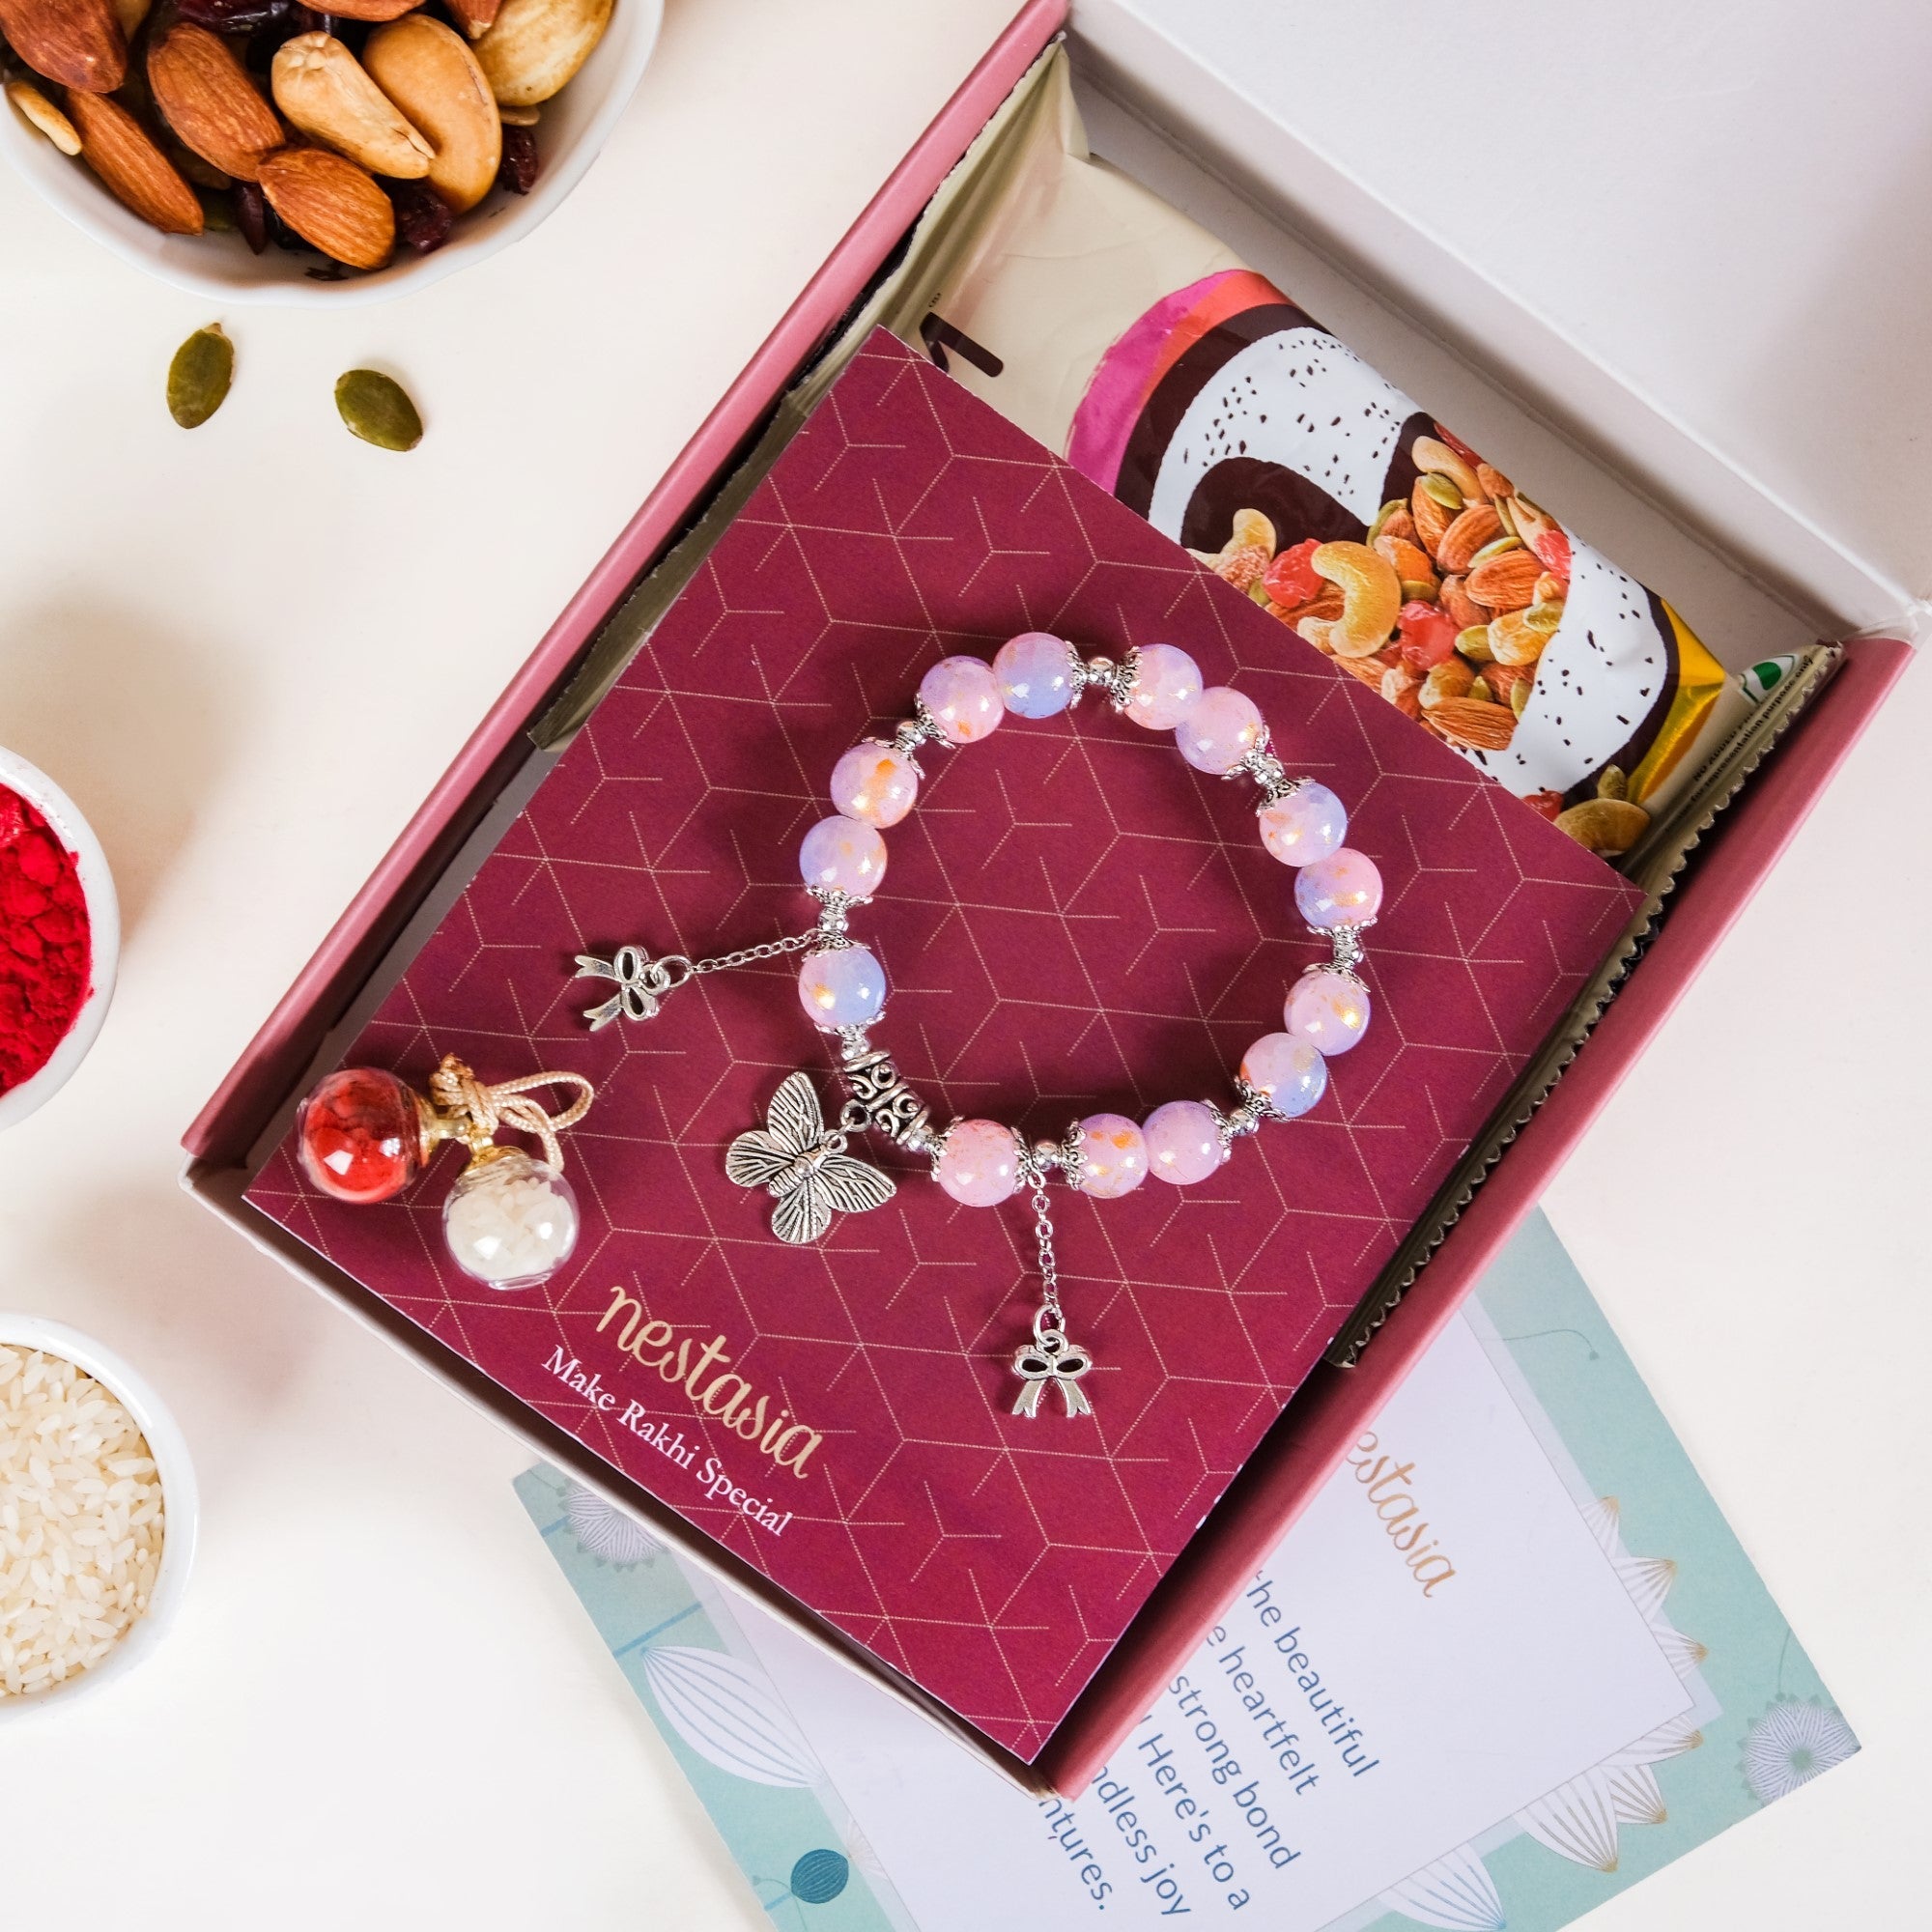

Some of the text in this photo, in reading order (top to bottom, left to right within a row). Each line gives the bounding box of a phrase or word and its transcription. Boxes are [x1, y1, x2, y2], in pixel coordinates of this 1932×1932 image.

[1762, 679, 1796, 720] purpose
[541, 1345, 794, 1537] Make Rakhi Special
[596, 1286, 823, 1479] nestasia
[1169, 1676, 1302, 1868] strong bond
[1219, 1646, 1321, 1795] heartfelt
[1273, 1626, 1380, 1777] beautiful
[1138, 1733, 1211, 1843] Here's
[1204, 1844, 1235, 1883] to
[1228, 1888, 1250, 1911] a
[1140, 1862, 1191, 1916] joy
